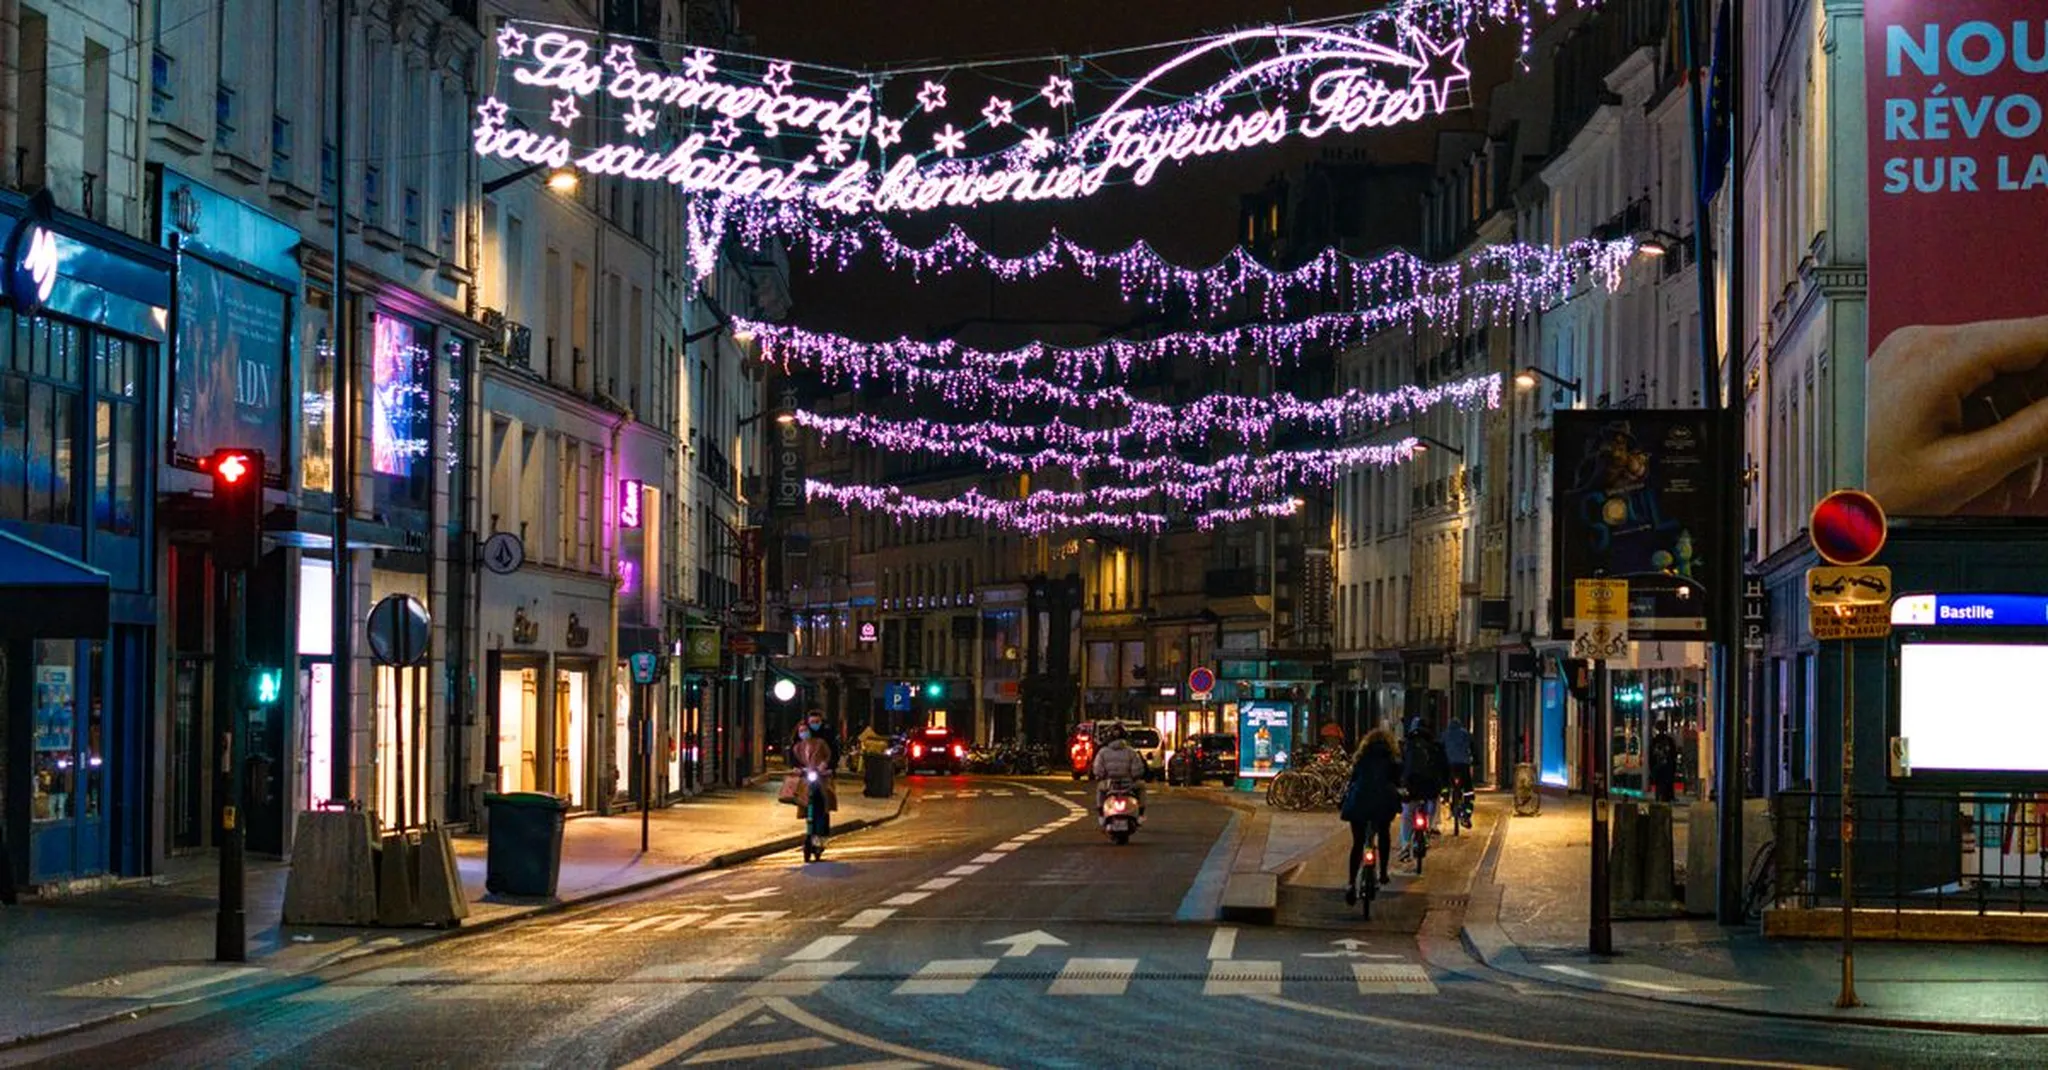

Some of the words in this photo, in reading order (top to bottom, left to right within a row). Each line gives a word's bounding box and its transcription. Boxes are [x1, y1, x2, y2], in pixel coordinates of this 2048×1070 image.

[514, 32, 602, 95] Les
[609, 68, 872, 137] commerçants
[1884, 83, 2043, 141] RÉVO
[1083, 108, 1287, 196] Joyeuses
[1302, 68, 1427, 138] Fêtes
[473, 125, 571, 168] vous
[576, 132, 818, 201] souhaitent
[873, 154, 1083, 210] bienvenue
[1883, 156, 1979, 193] SUR
[1998, 153, 2048, 190] LA
[235, 358, 270, 408] ADN
[779, 387, 799, 447] roet
[778, 451, 802, 506] ligne
[1940, 605, 1994, 619] Bastille
